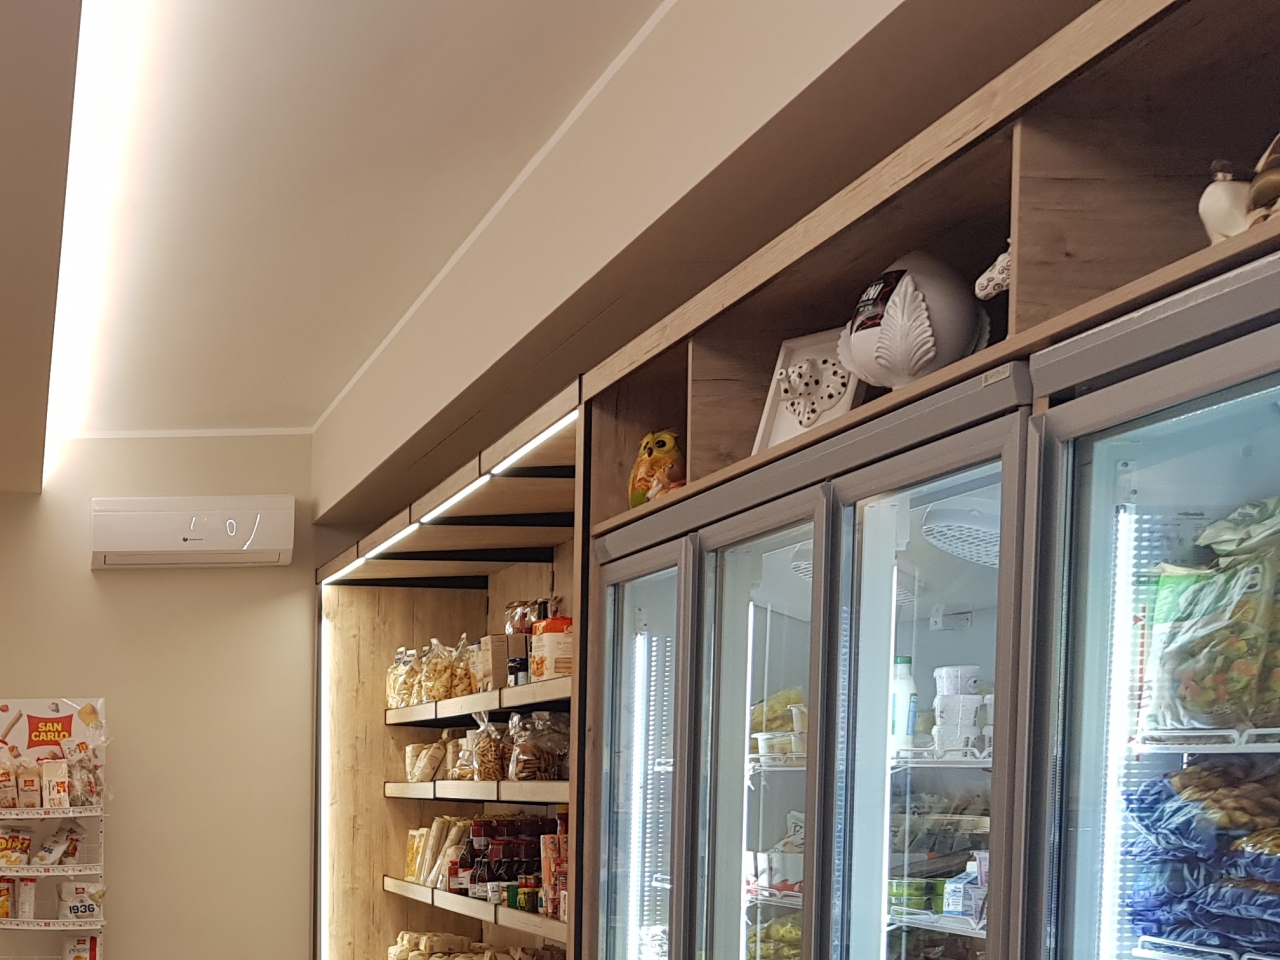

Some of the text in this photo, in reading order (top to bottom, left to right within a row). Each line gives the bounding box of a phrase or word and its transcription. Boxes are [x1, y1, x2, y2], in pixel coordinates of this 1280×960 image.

[38, 722, 62, 731] SAN
[31, 731, 69, 741] CARLO
[69, 903, 95, 914] 1936
